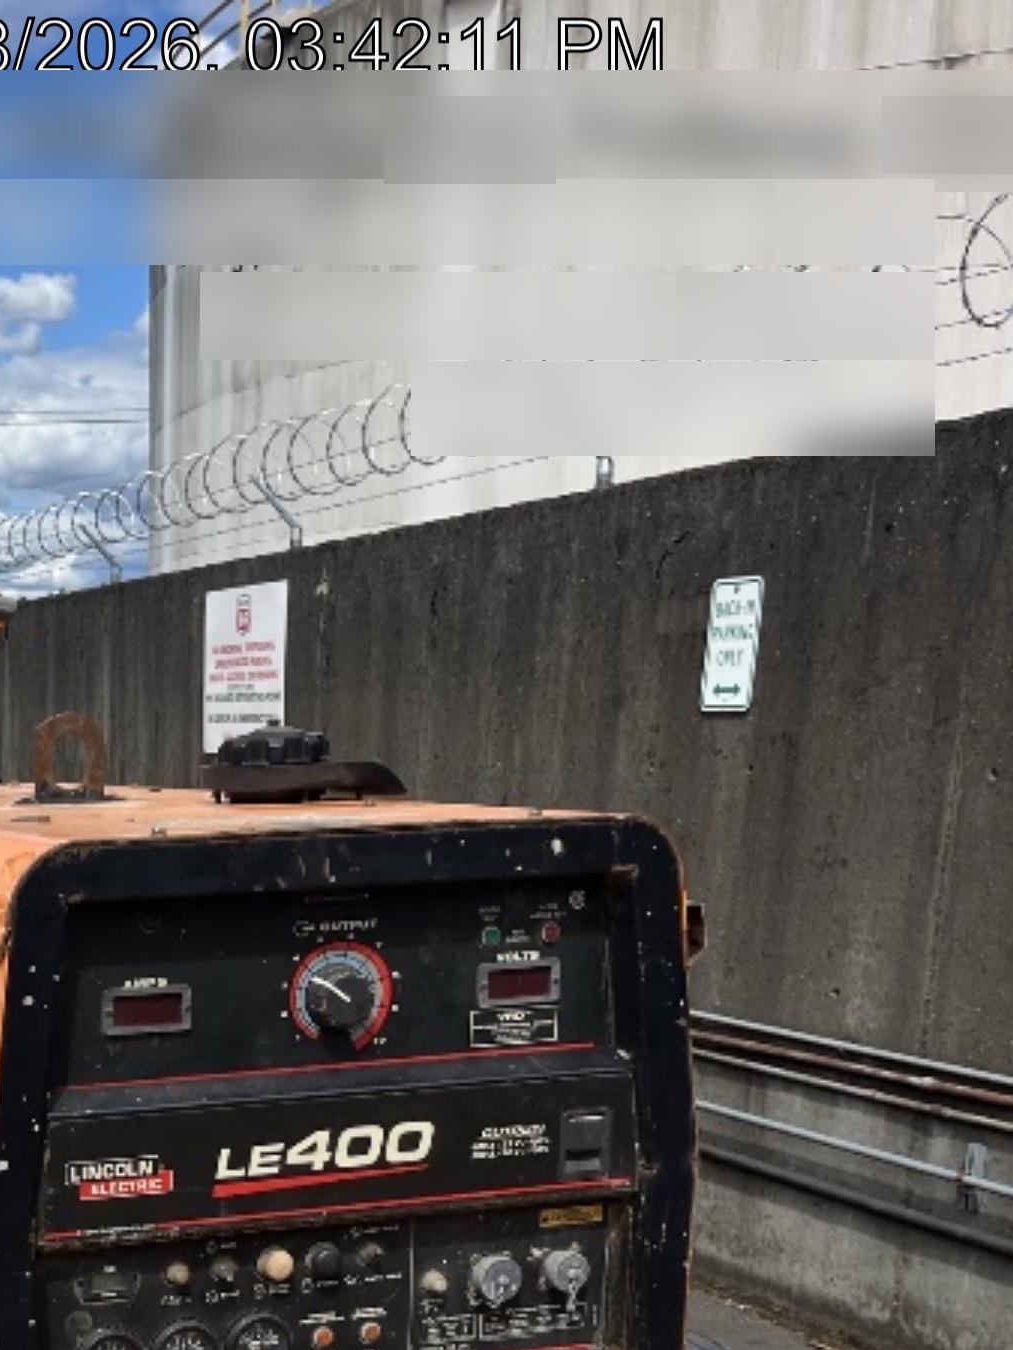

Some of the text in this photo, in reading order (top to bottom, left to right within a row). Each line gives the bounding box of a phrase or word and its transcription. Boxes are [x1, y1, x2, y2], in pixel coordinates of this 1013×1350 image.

[214, 1121, 436, 1180] LE400
[69, 1159, 154, 1182] LINCOLN
[90, 1177, 163, 1196] ELECTRIC
